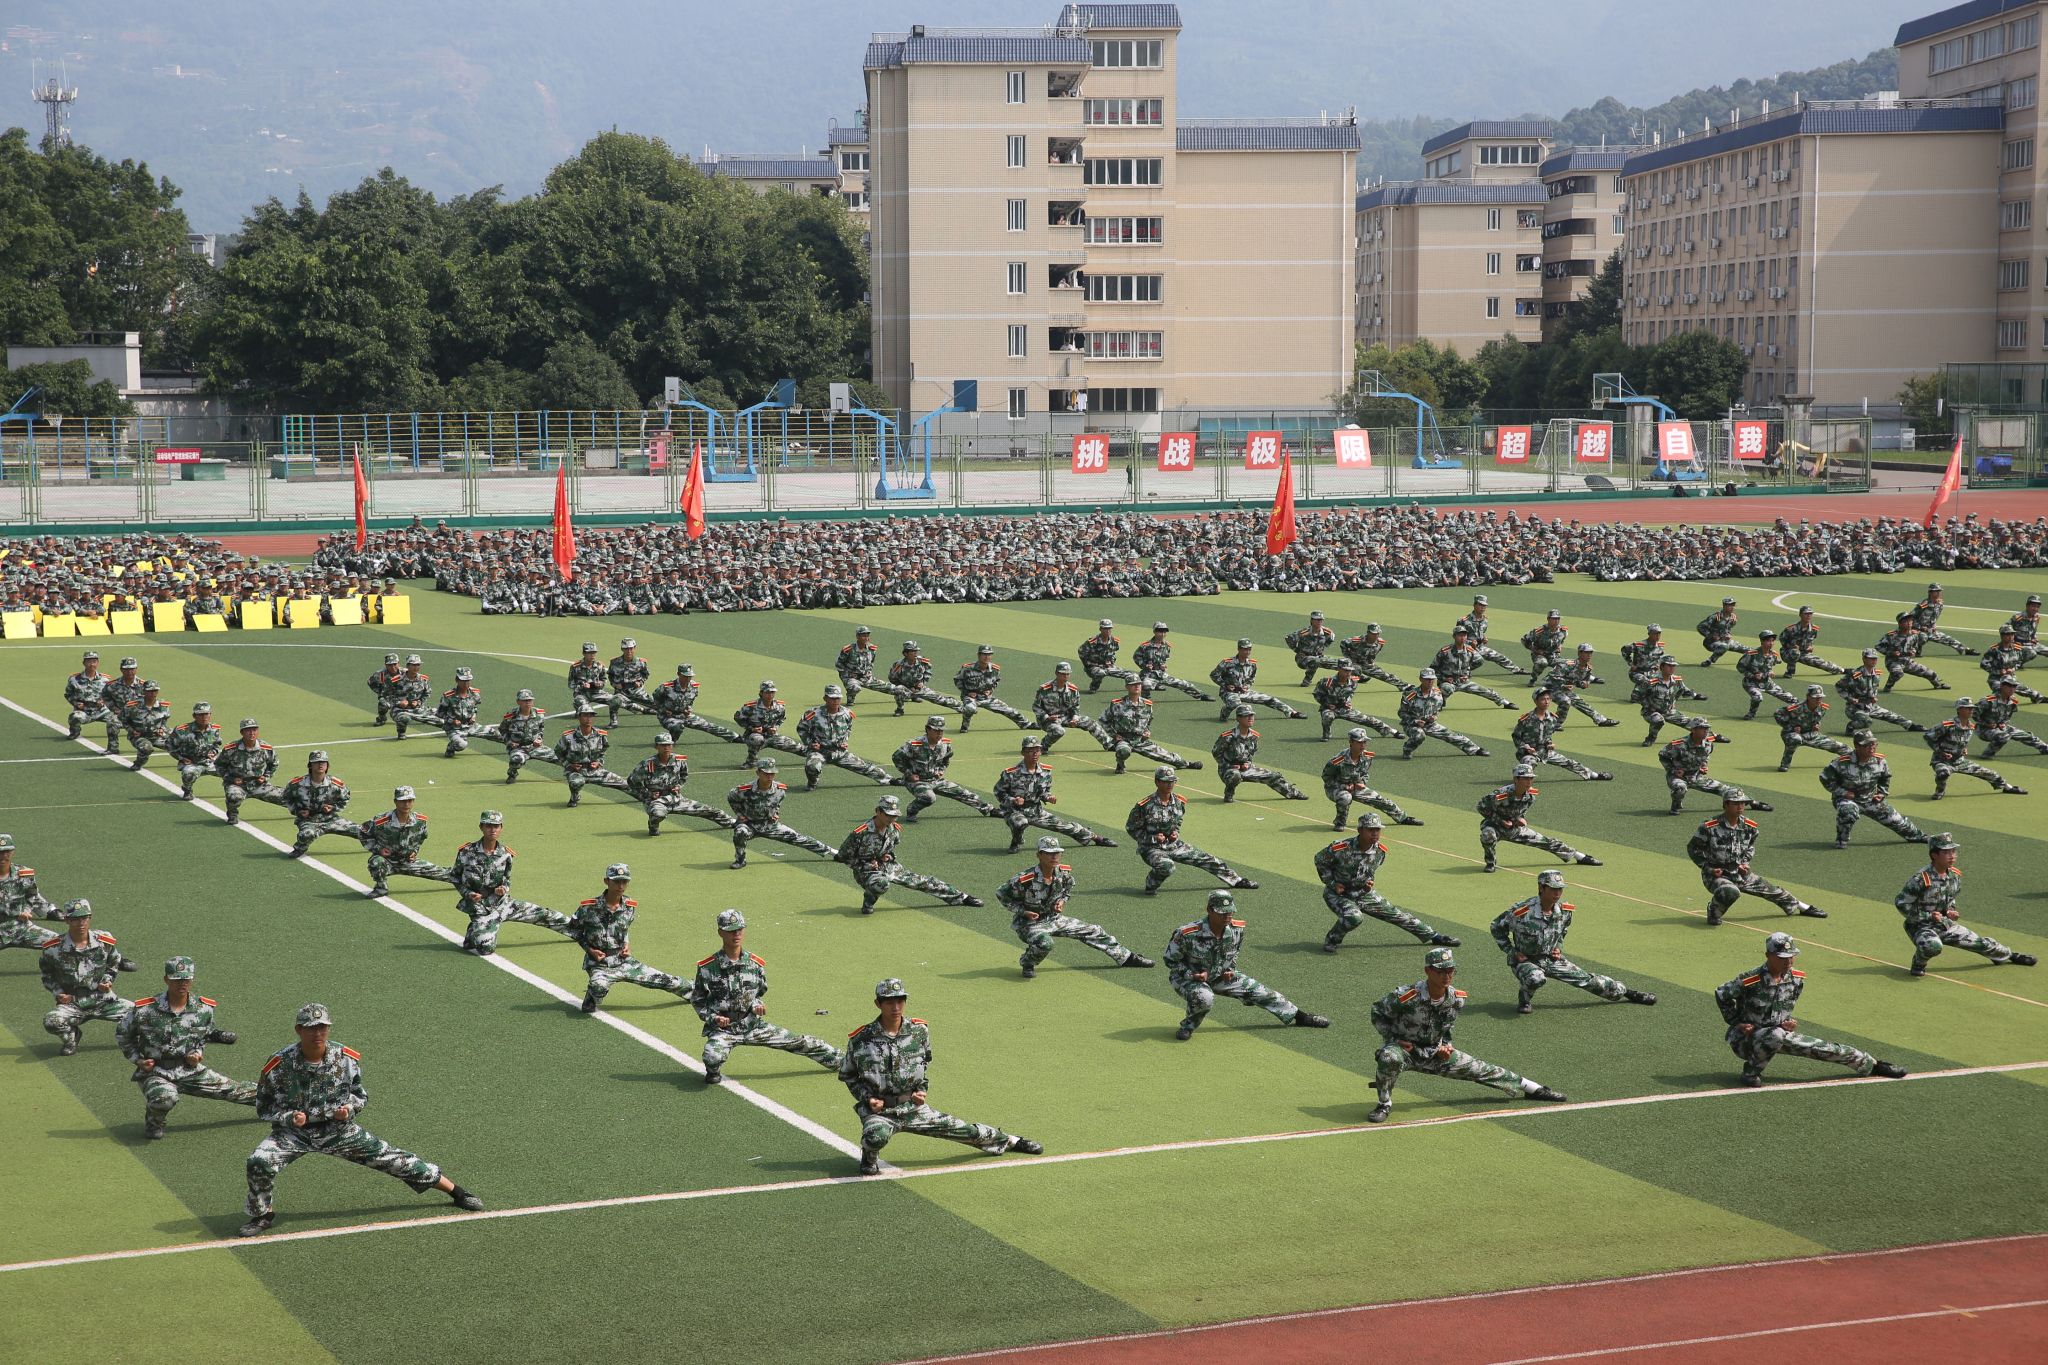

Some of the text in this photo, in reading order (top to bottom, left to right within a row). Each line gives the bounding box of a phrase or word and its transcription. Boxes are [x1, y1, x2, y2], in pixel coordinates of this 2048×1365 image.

[1077, 440, 1104, 468] 挑
[1163, 438, 1191, 466] 战
[1250, 437, 1276, 465] 极
[1340, 436, 1367, 462] 限
[1501, 432, 1526, 458] 超
[1582, 430, 1606, 457] 越
[1667, 429, 1689, 455] 自
[1739, 427, 1763, 454] 我
